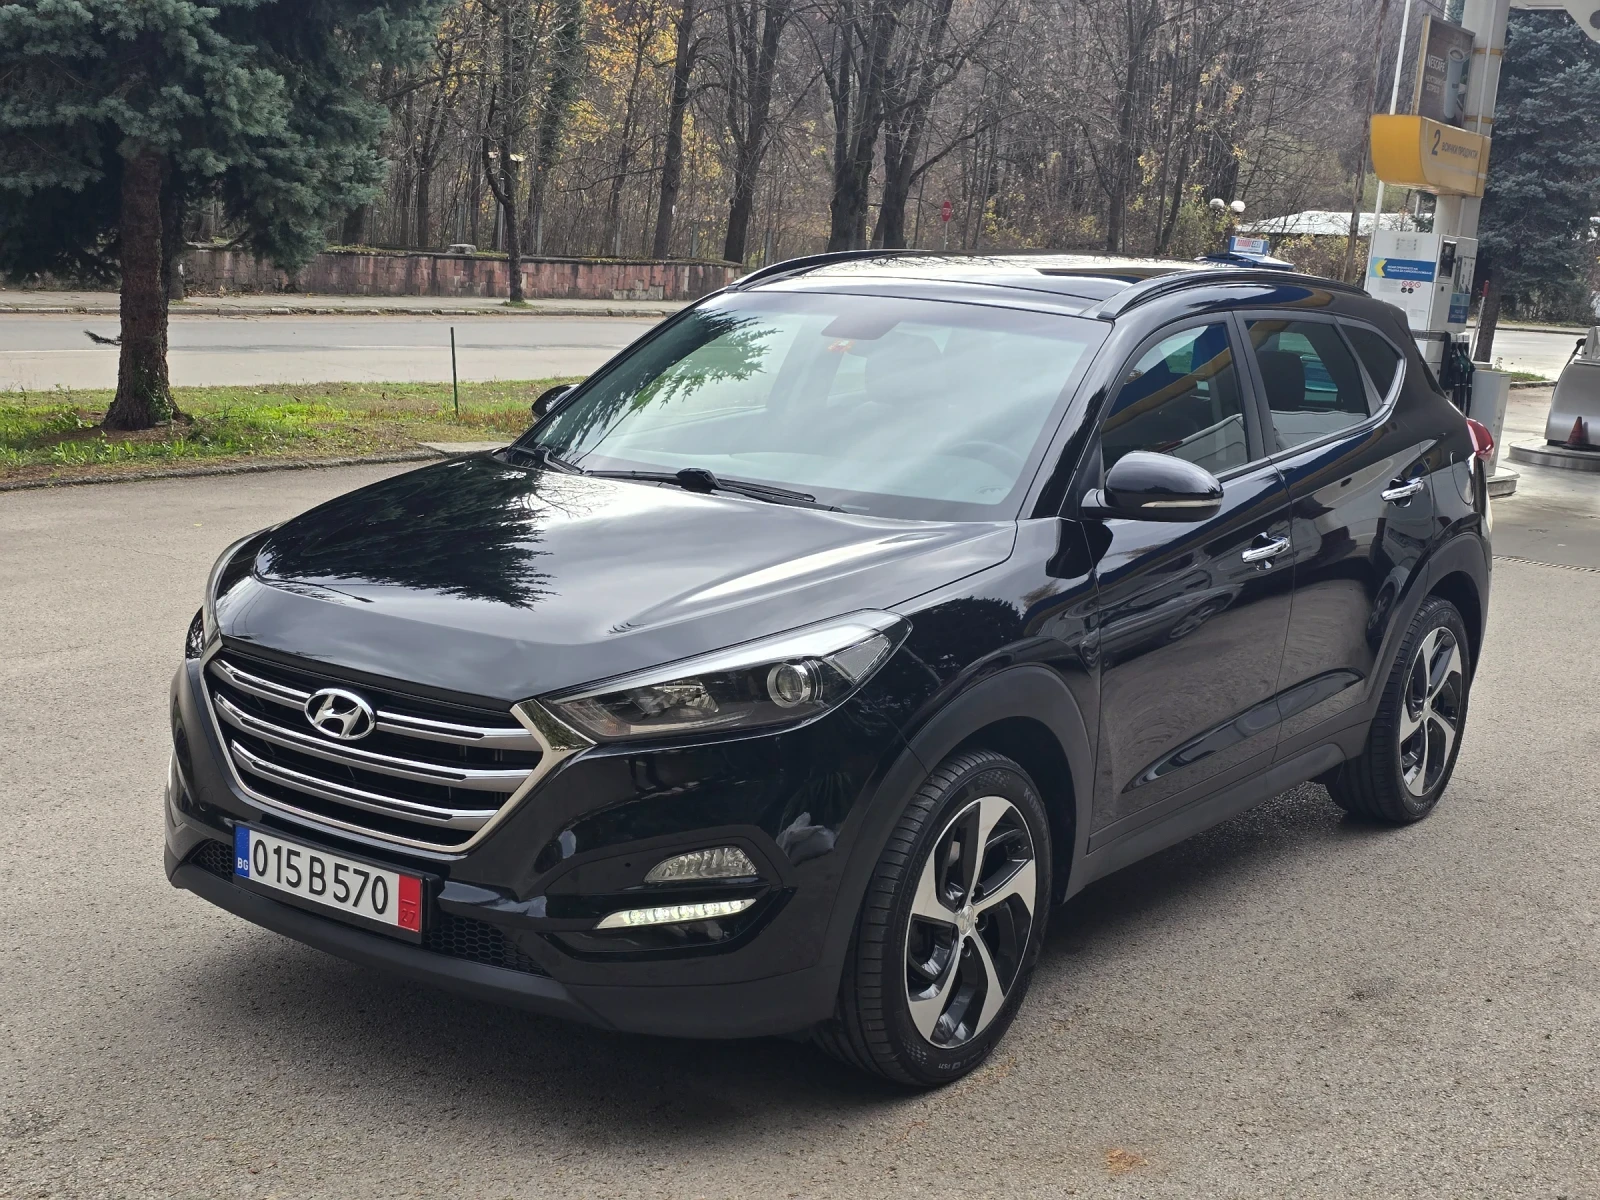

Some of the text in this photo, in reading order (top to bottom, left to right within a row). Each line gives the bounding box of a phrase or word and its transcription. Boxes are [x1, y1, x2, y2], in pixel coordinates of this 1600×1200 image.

[1431, 129, 1441, 156] 2
[237, 857, 249, 871] BG
[401, 909, 416, 924] 27
